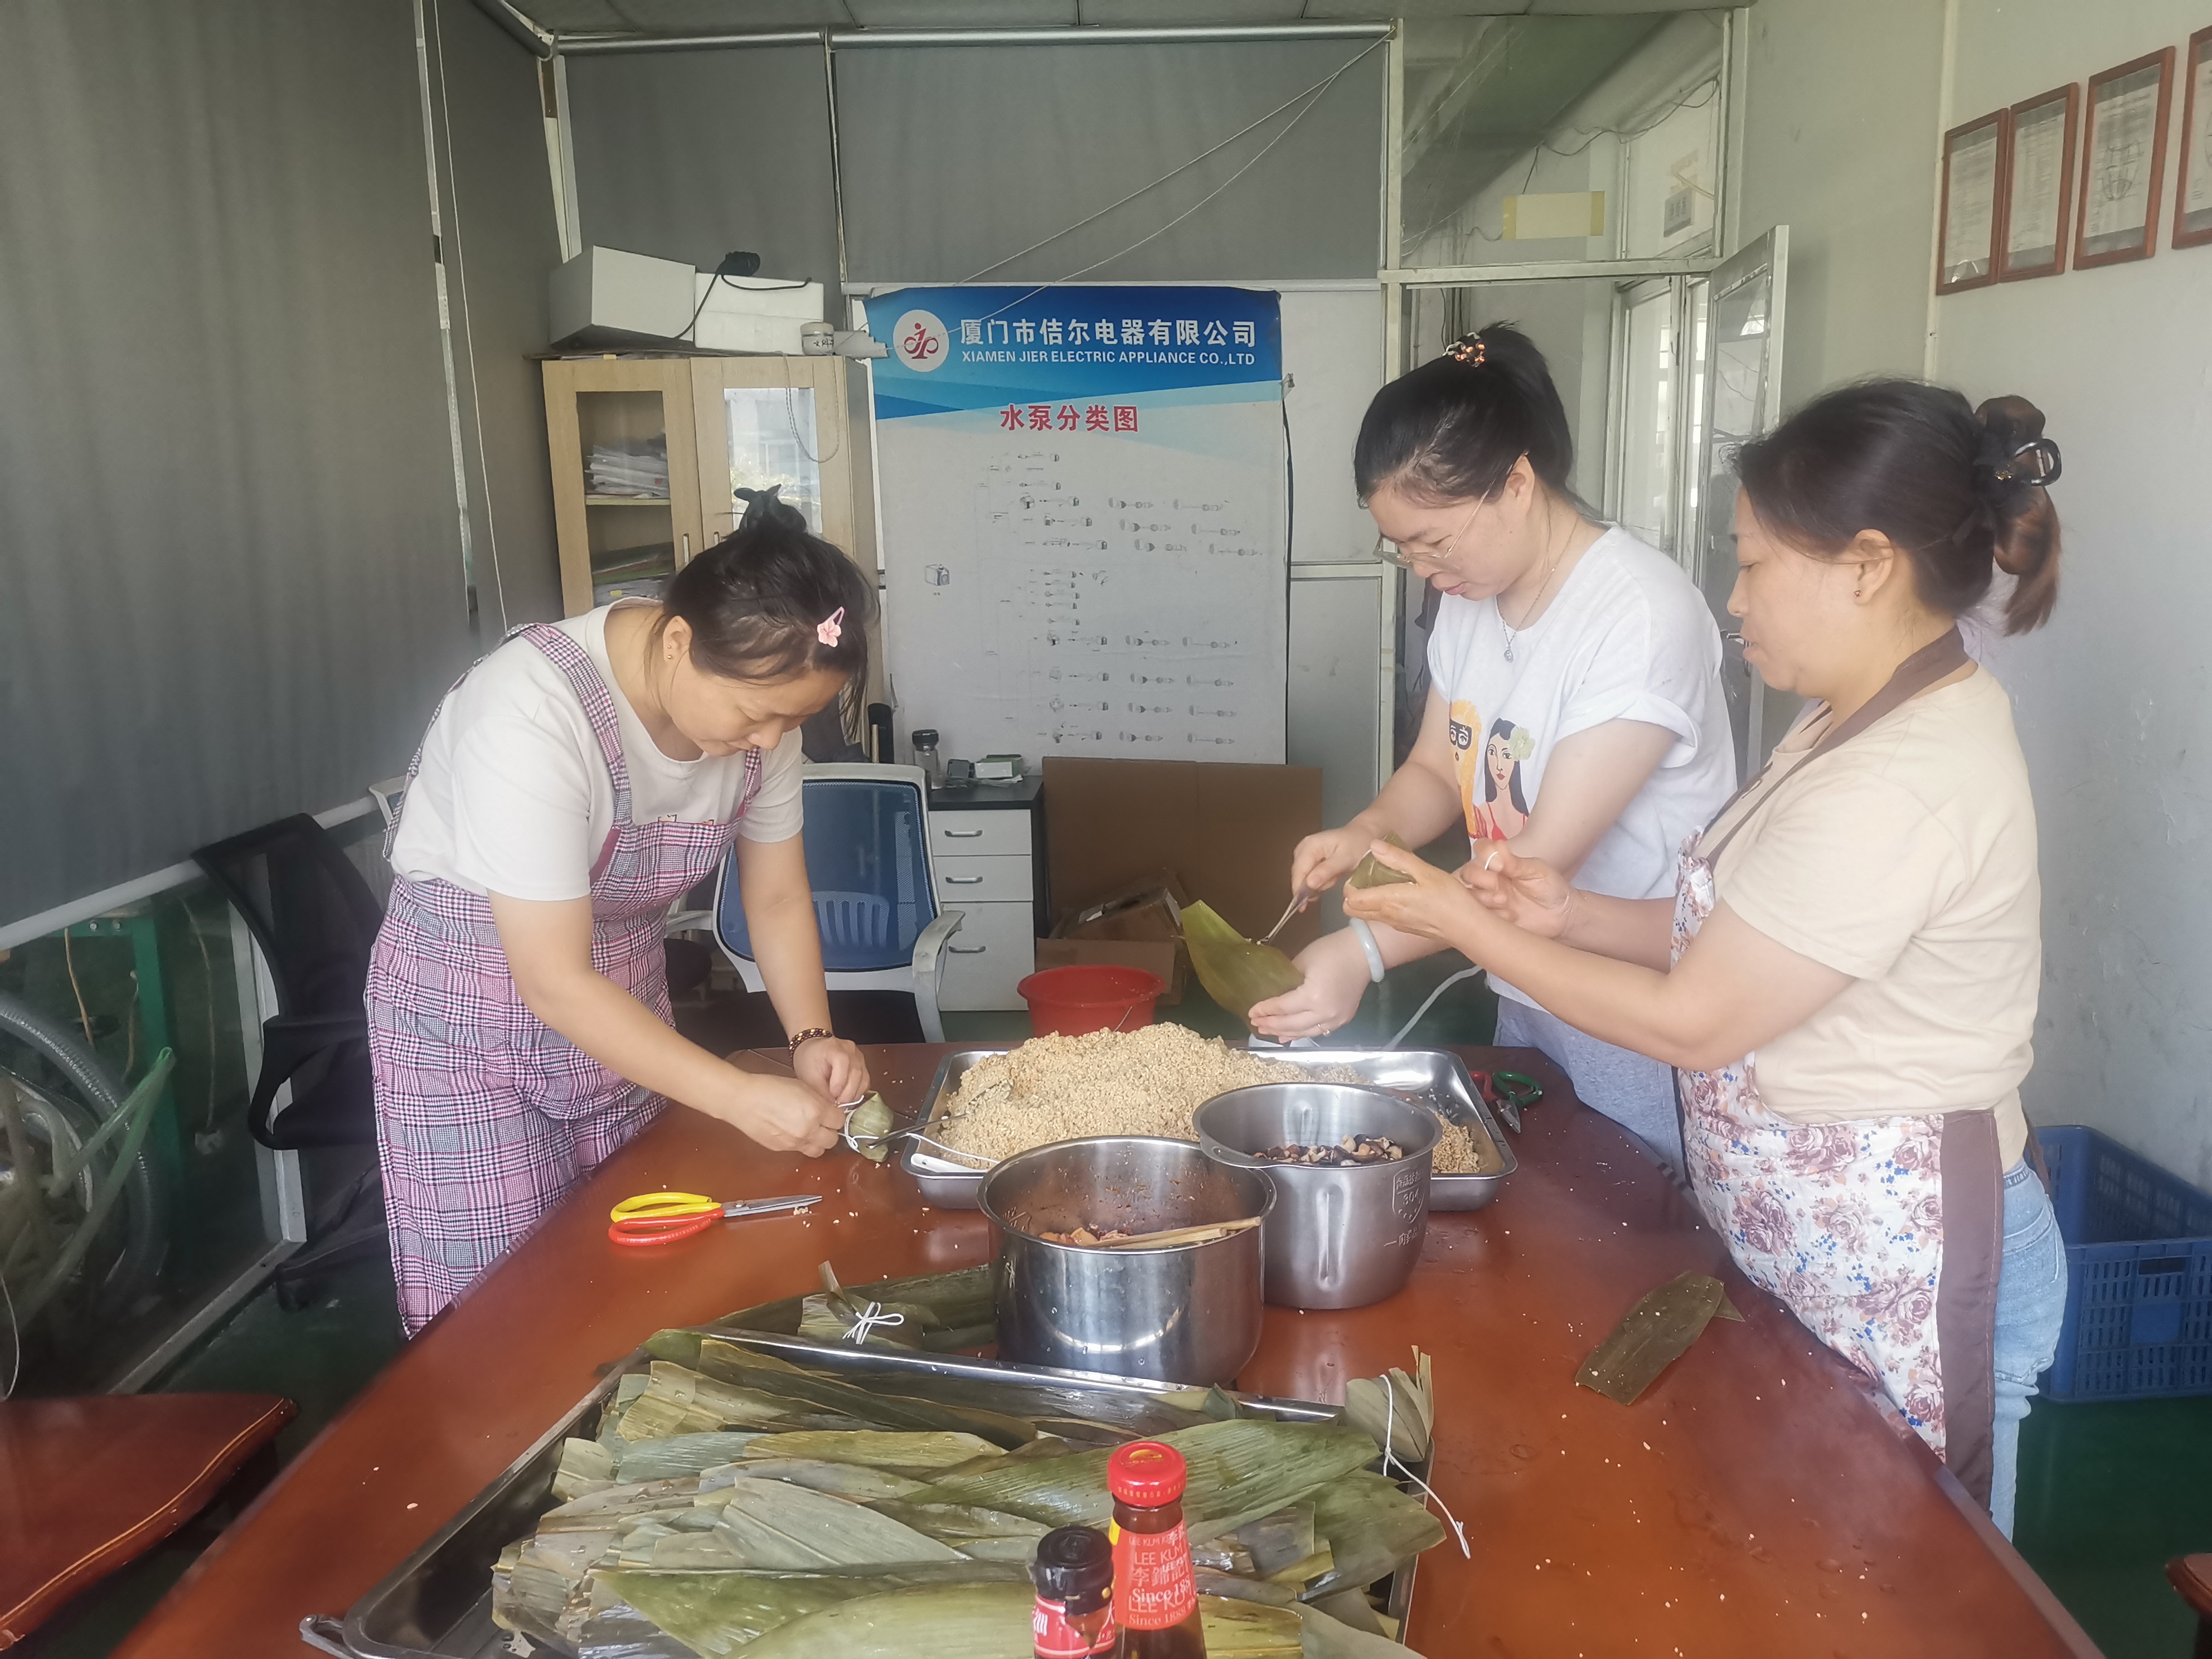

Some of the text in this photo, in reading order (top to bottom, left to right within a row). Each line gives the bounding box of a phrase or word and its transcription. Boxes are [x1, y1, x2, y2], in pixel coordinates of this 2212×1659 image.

[961, 318, 1255, 347] 厦门市佶尔电器有限公司
[962, 351, 1255, 366] XIAMEN JIER ELECTRIC APPLIANCE CO.,LTD
[1000, 404, 1138, 432] 水泵分类图
[1134, 1551, 1157, 1565] LEE
[1160, 1541, 1183, 1564] KUM
[1132, 1587, 1172, 1603] Since
